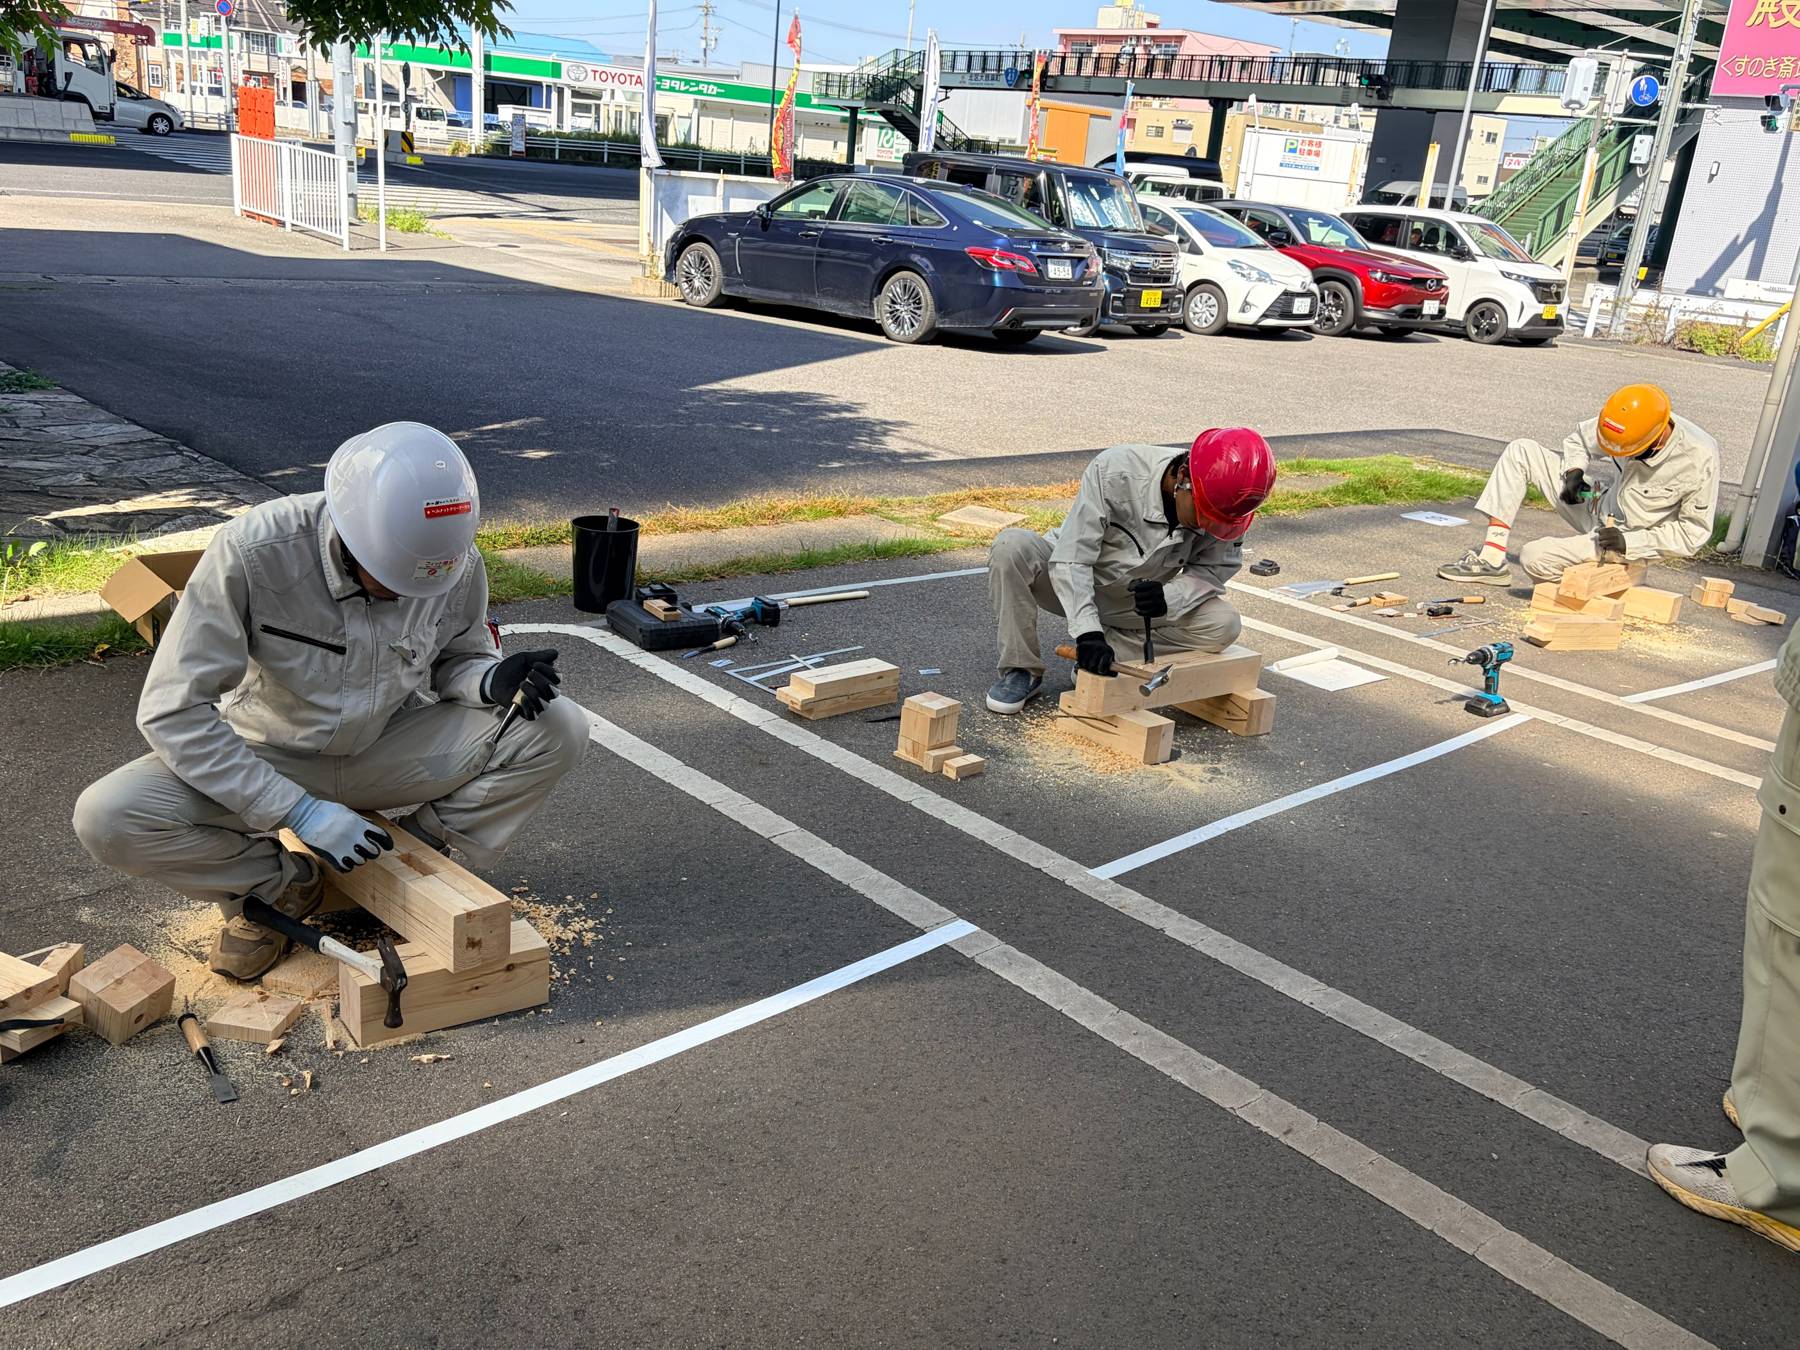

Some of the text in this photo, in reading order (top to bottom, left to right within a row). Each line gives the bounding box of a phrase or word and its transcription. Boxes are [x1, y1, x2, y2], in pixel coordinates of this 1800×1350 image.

[1720, 54, 1800, 79] くすのき斎
[591, 69, 643, 87] TOYOTA
[1300, 139, 1322, 149] お客様
[1298, 147, 1321, 158] 駐車場
